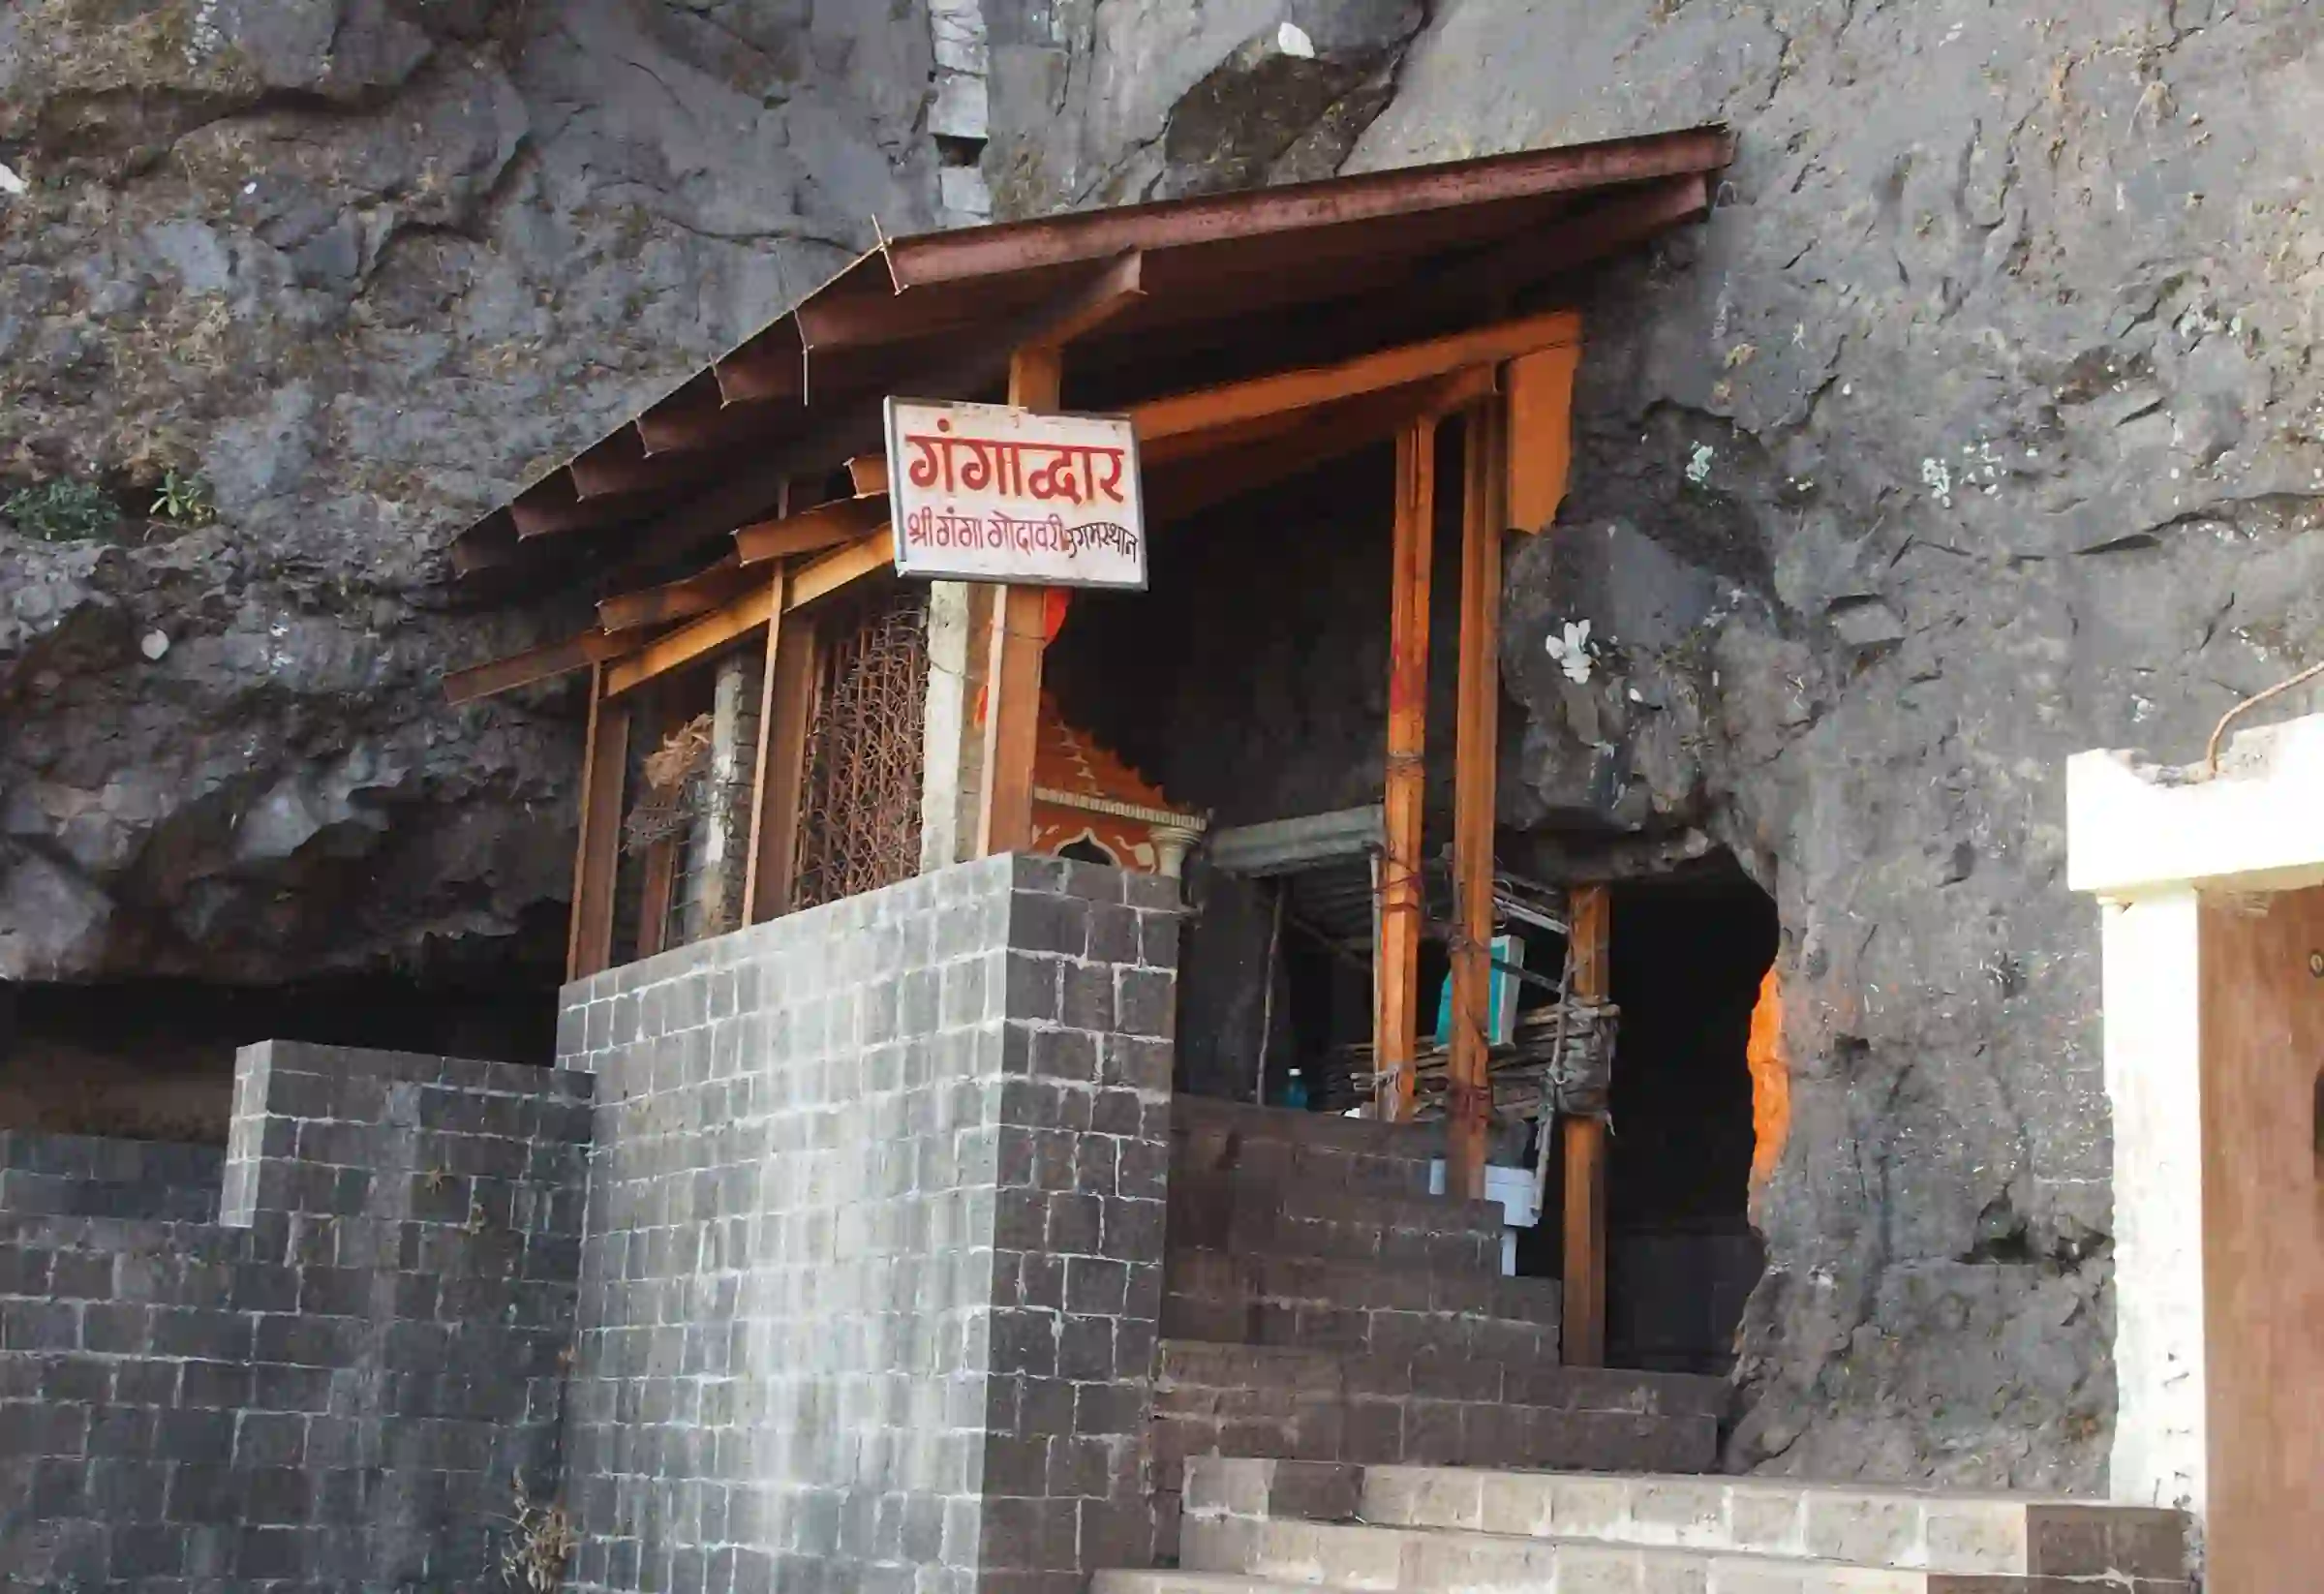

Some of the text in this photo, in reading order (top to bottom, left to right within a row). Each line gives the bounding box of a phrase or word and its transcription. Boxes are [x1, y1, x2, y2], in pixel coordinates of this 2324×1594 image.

[904, 418, 1125, 505] गंगाद्वार
[907, 506, 933, 547] श्री
[936, 506, 984, 549] गंगा
[988, 509, 1065, 557] गोदावरी
